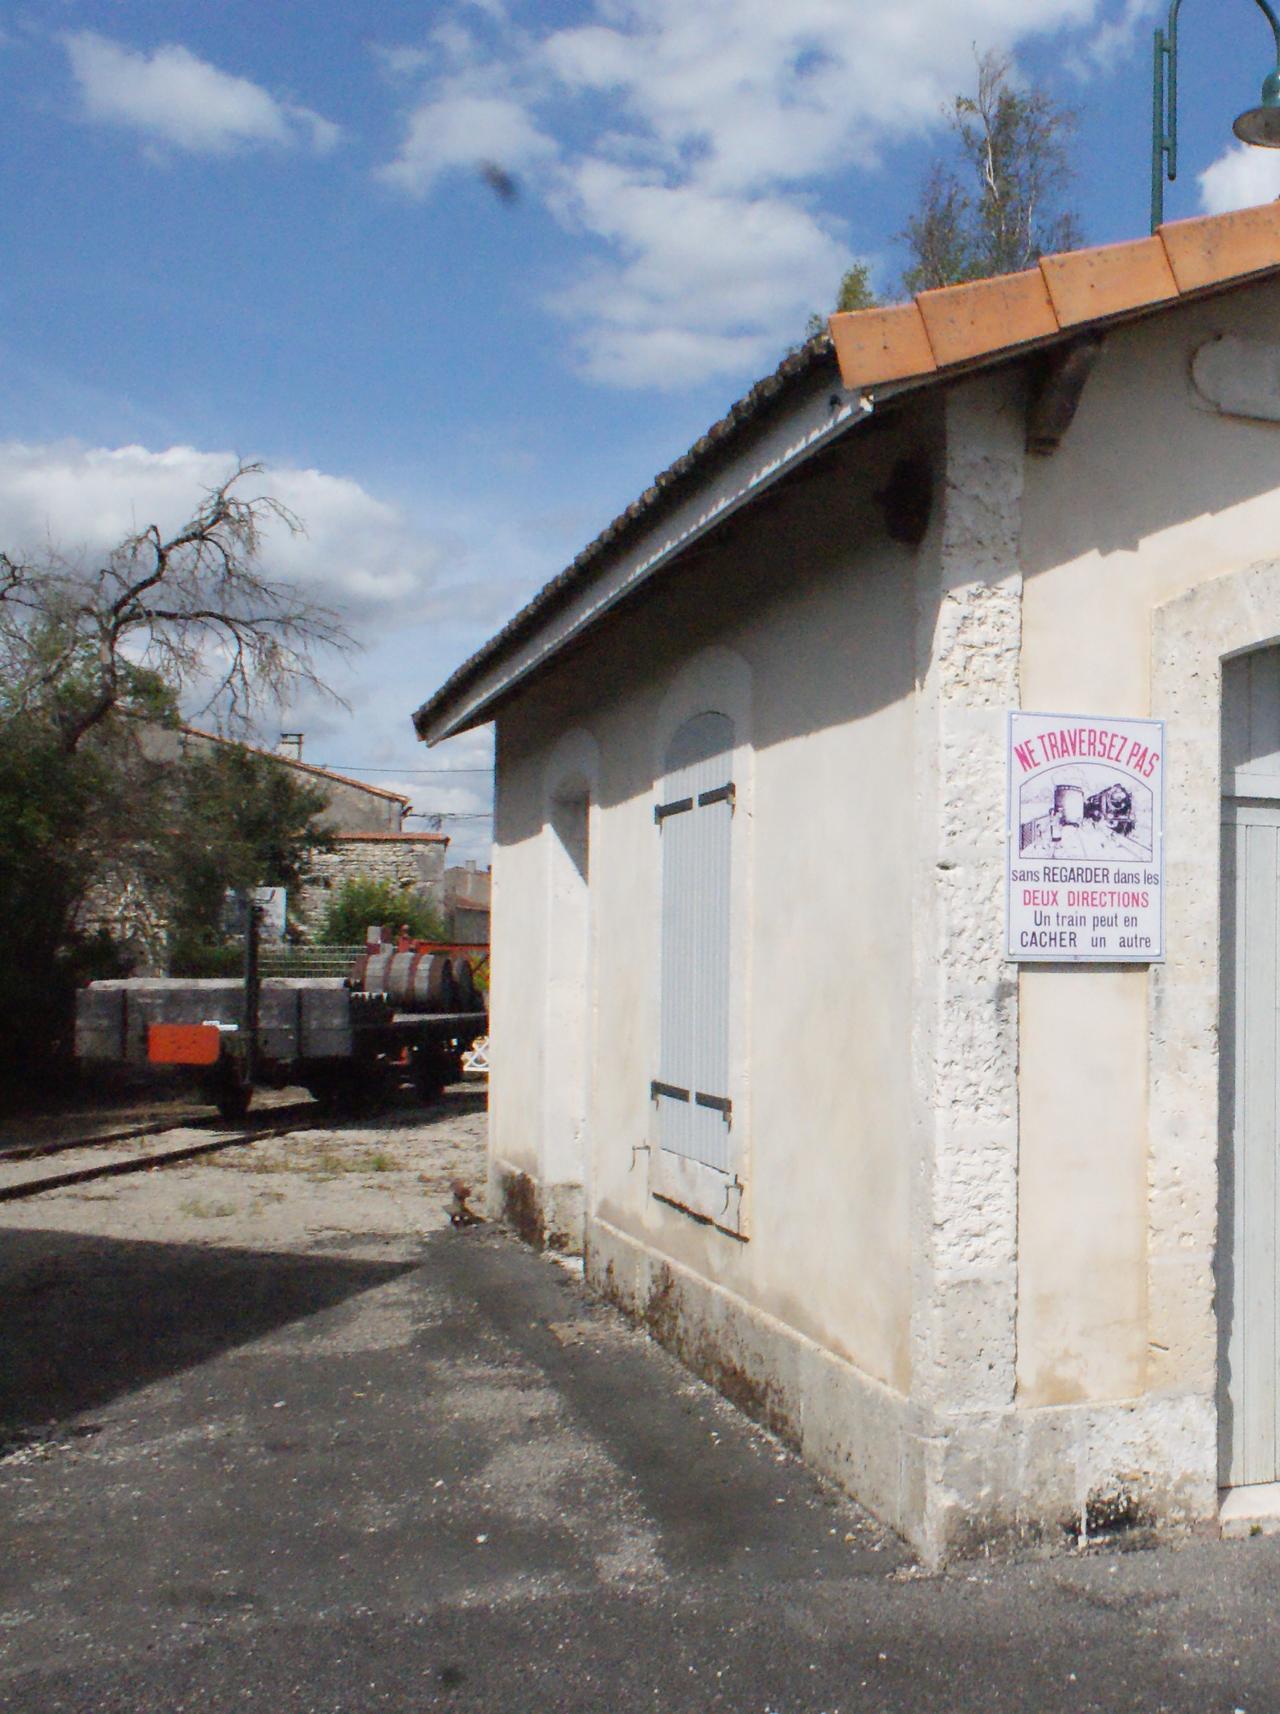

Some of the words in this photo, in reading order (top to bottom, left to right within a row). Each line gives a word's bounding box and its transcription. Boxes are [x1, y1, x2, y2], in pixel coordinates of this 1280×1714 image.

[1014, 739, 1041, 773] NE
[1037, 728, 1128, 763] TRAVERSEZ
[1126, 742, 1160, 778] PAS
[1011, 869, 1040, 882] sans
[1043, 866, 1110, 884] REGARDER
[1114, 868, 1141, 885] dans
[1143, 869, 1160, 885] les
[1023, 889, 1059, 906] DEUX
[1067, 890, 1150, 908] DIRECTIONS
[1034, 910, 1050, 927] Un
[1056, 911, 1086, 927] train
[1092, 913, 1118, 931] peut
[1123, 916, 1138, 928] en
[1020, 931, 1077, 948] CACHER
[1091, 936, 1106, 948] un
[1119, 934, 1151, 948] autre
